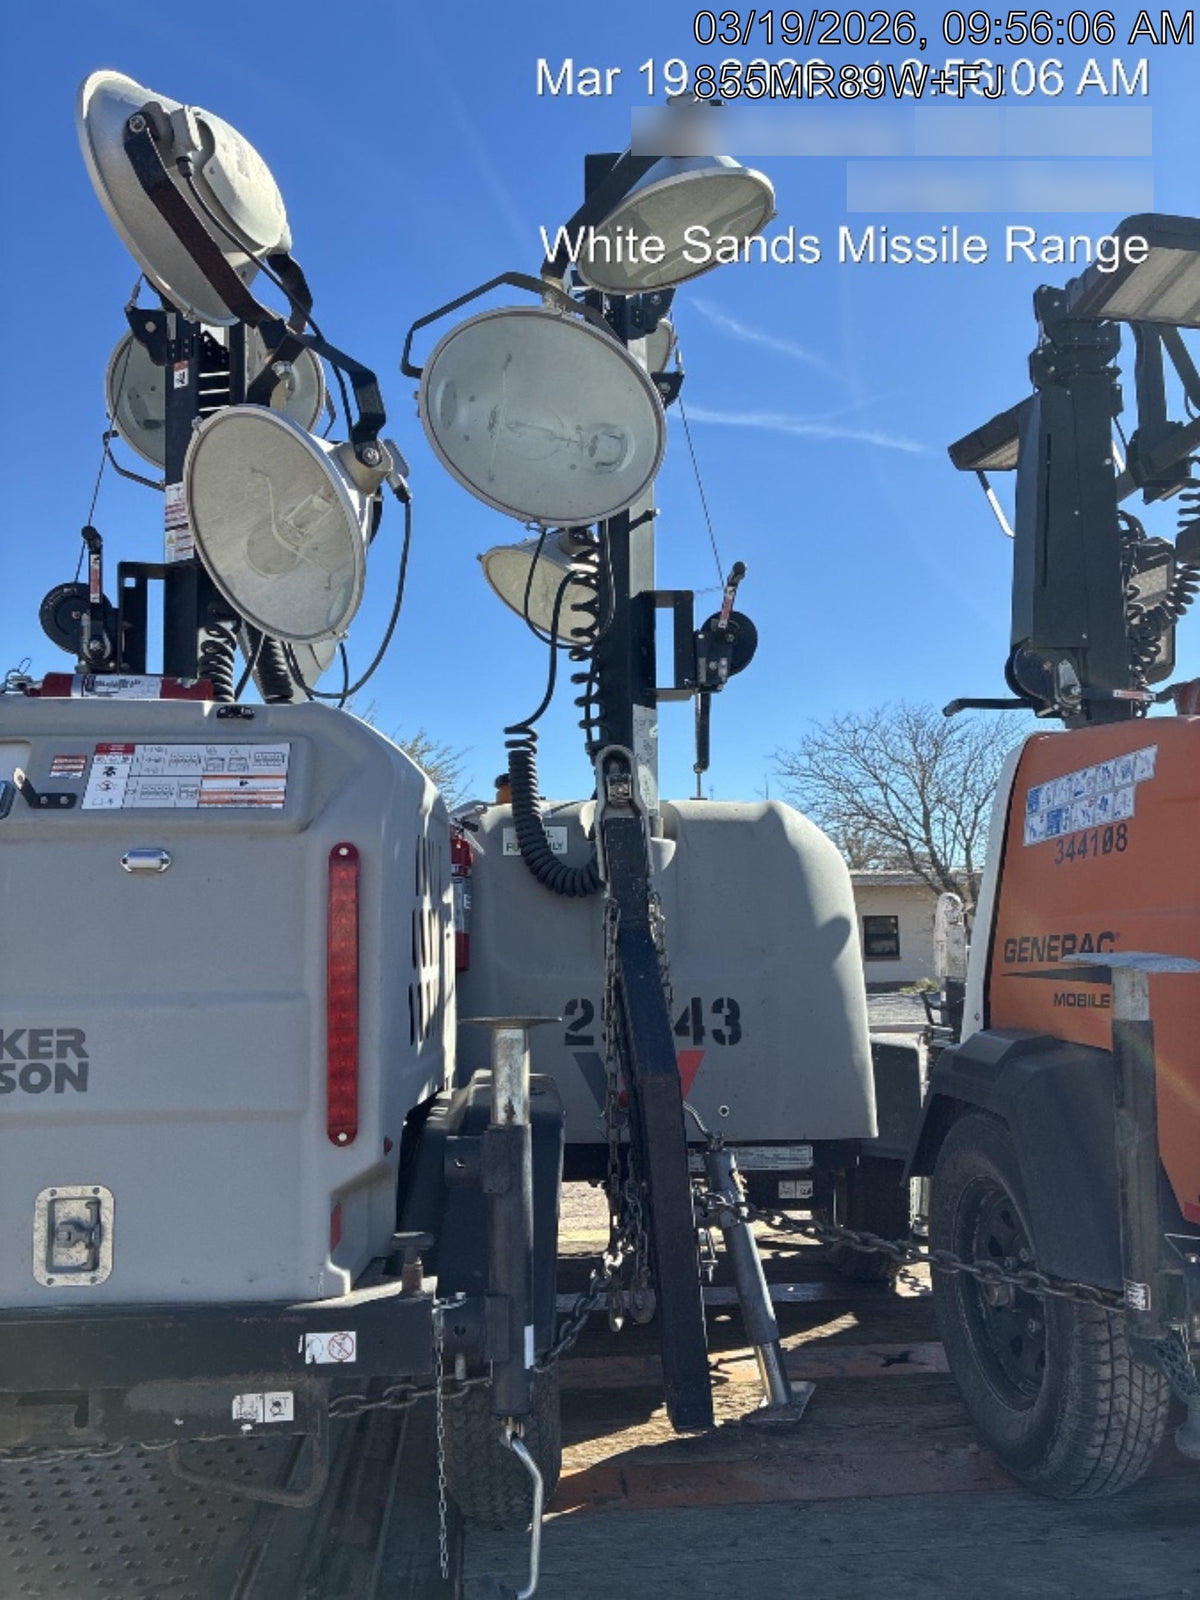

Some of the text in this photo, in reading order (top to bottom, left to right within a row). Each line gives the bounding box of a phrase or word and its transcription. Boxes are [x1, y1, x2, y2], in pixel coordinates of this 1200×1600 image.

[1055, 823, 1128, 864] 344108
[1004, 931, 1115, 963] GENERAC
[1053, 993, 1110, 1008] MOBILE
[0, 1028, 89, 1059] KER
[0, 1061, 89, 1094] SON
